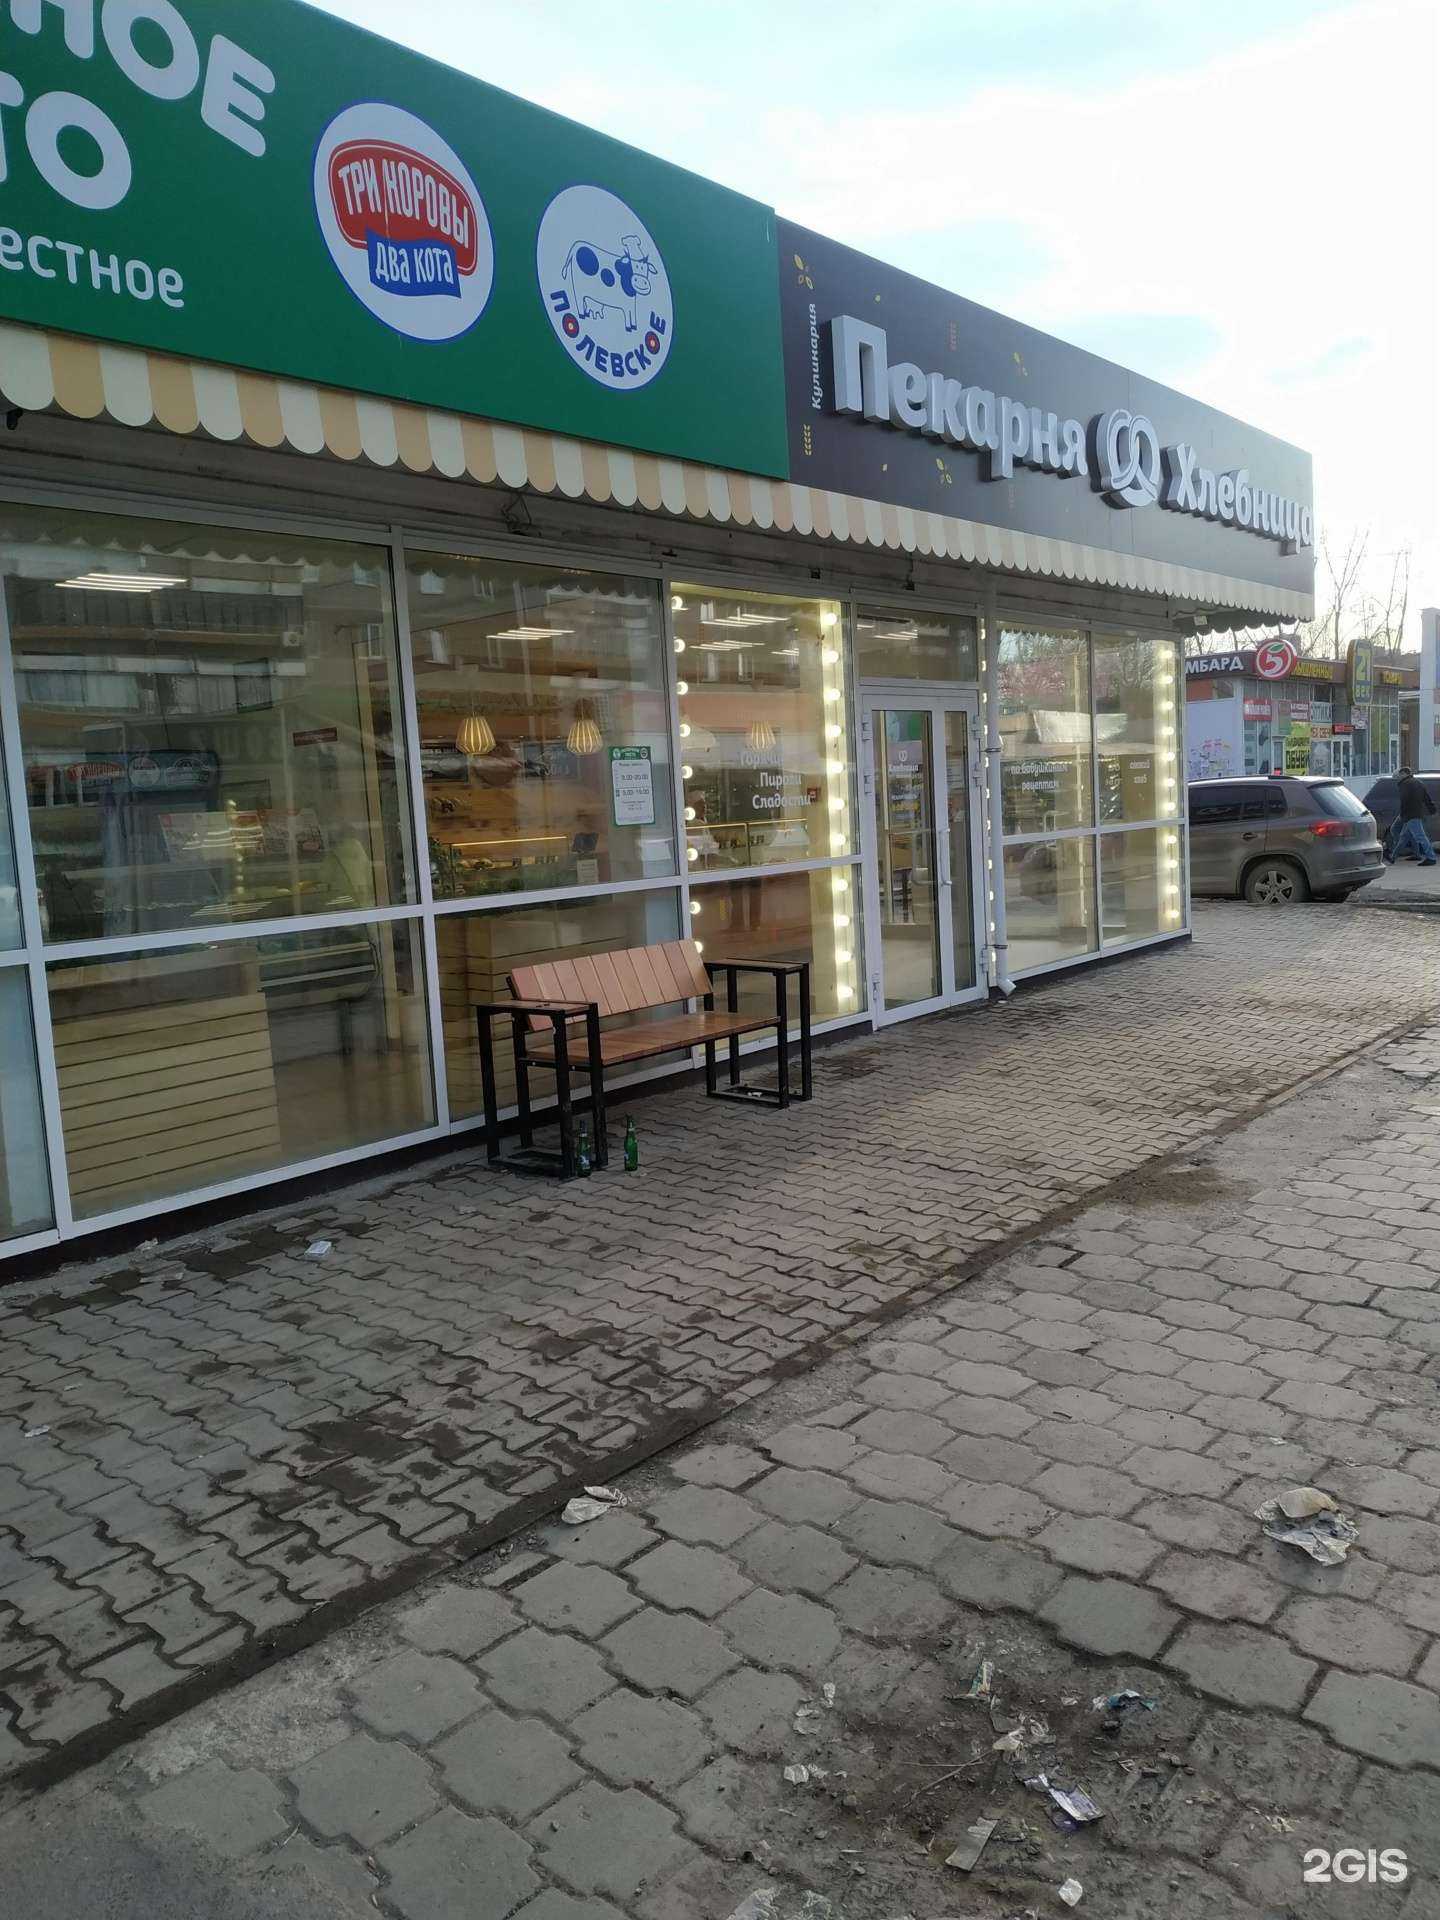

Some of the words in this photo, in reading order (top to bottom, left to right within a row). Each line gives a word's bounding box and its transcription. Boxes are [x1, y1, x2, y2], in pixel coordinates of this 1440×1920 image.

[338, 158, 382, 216] ТРИ
[0, 226, 185, 308] естное
[550, 290, 667, 378] ПОЛЕВСКОЕ
[808, 303, 823, 409] Кулинария
[831, 314, 1088, 480] Пекарня
[1176, 442, 1313, 554] Хлебница
[1185, 656, 1244, 674] МБАРД
[752, 793, 812, 809] Сладости
